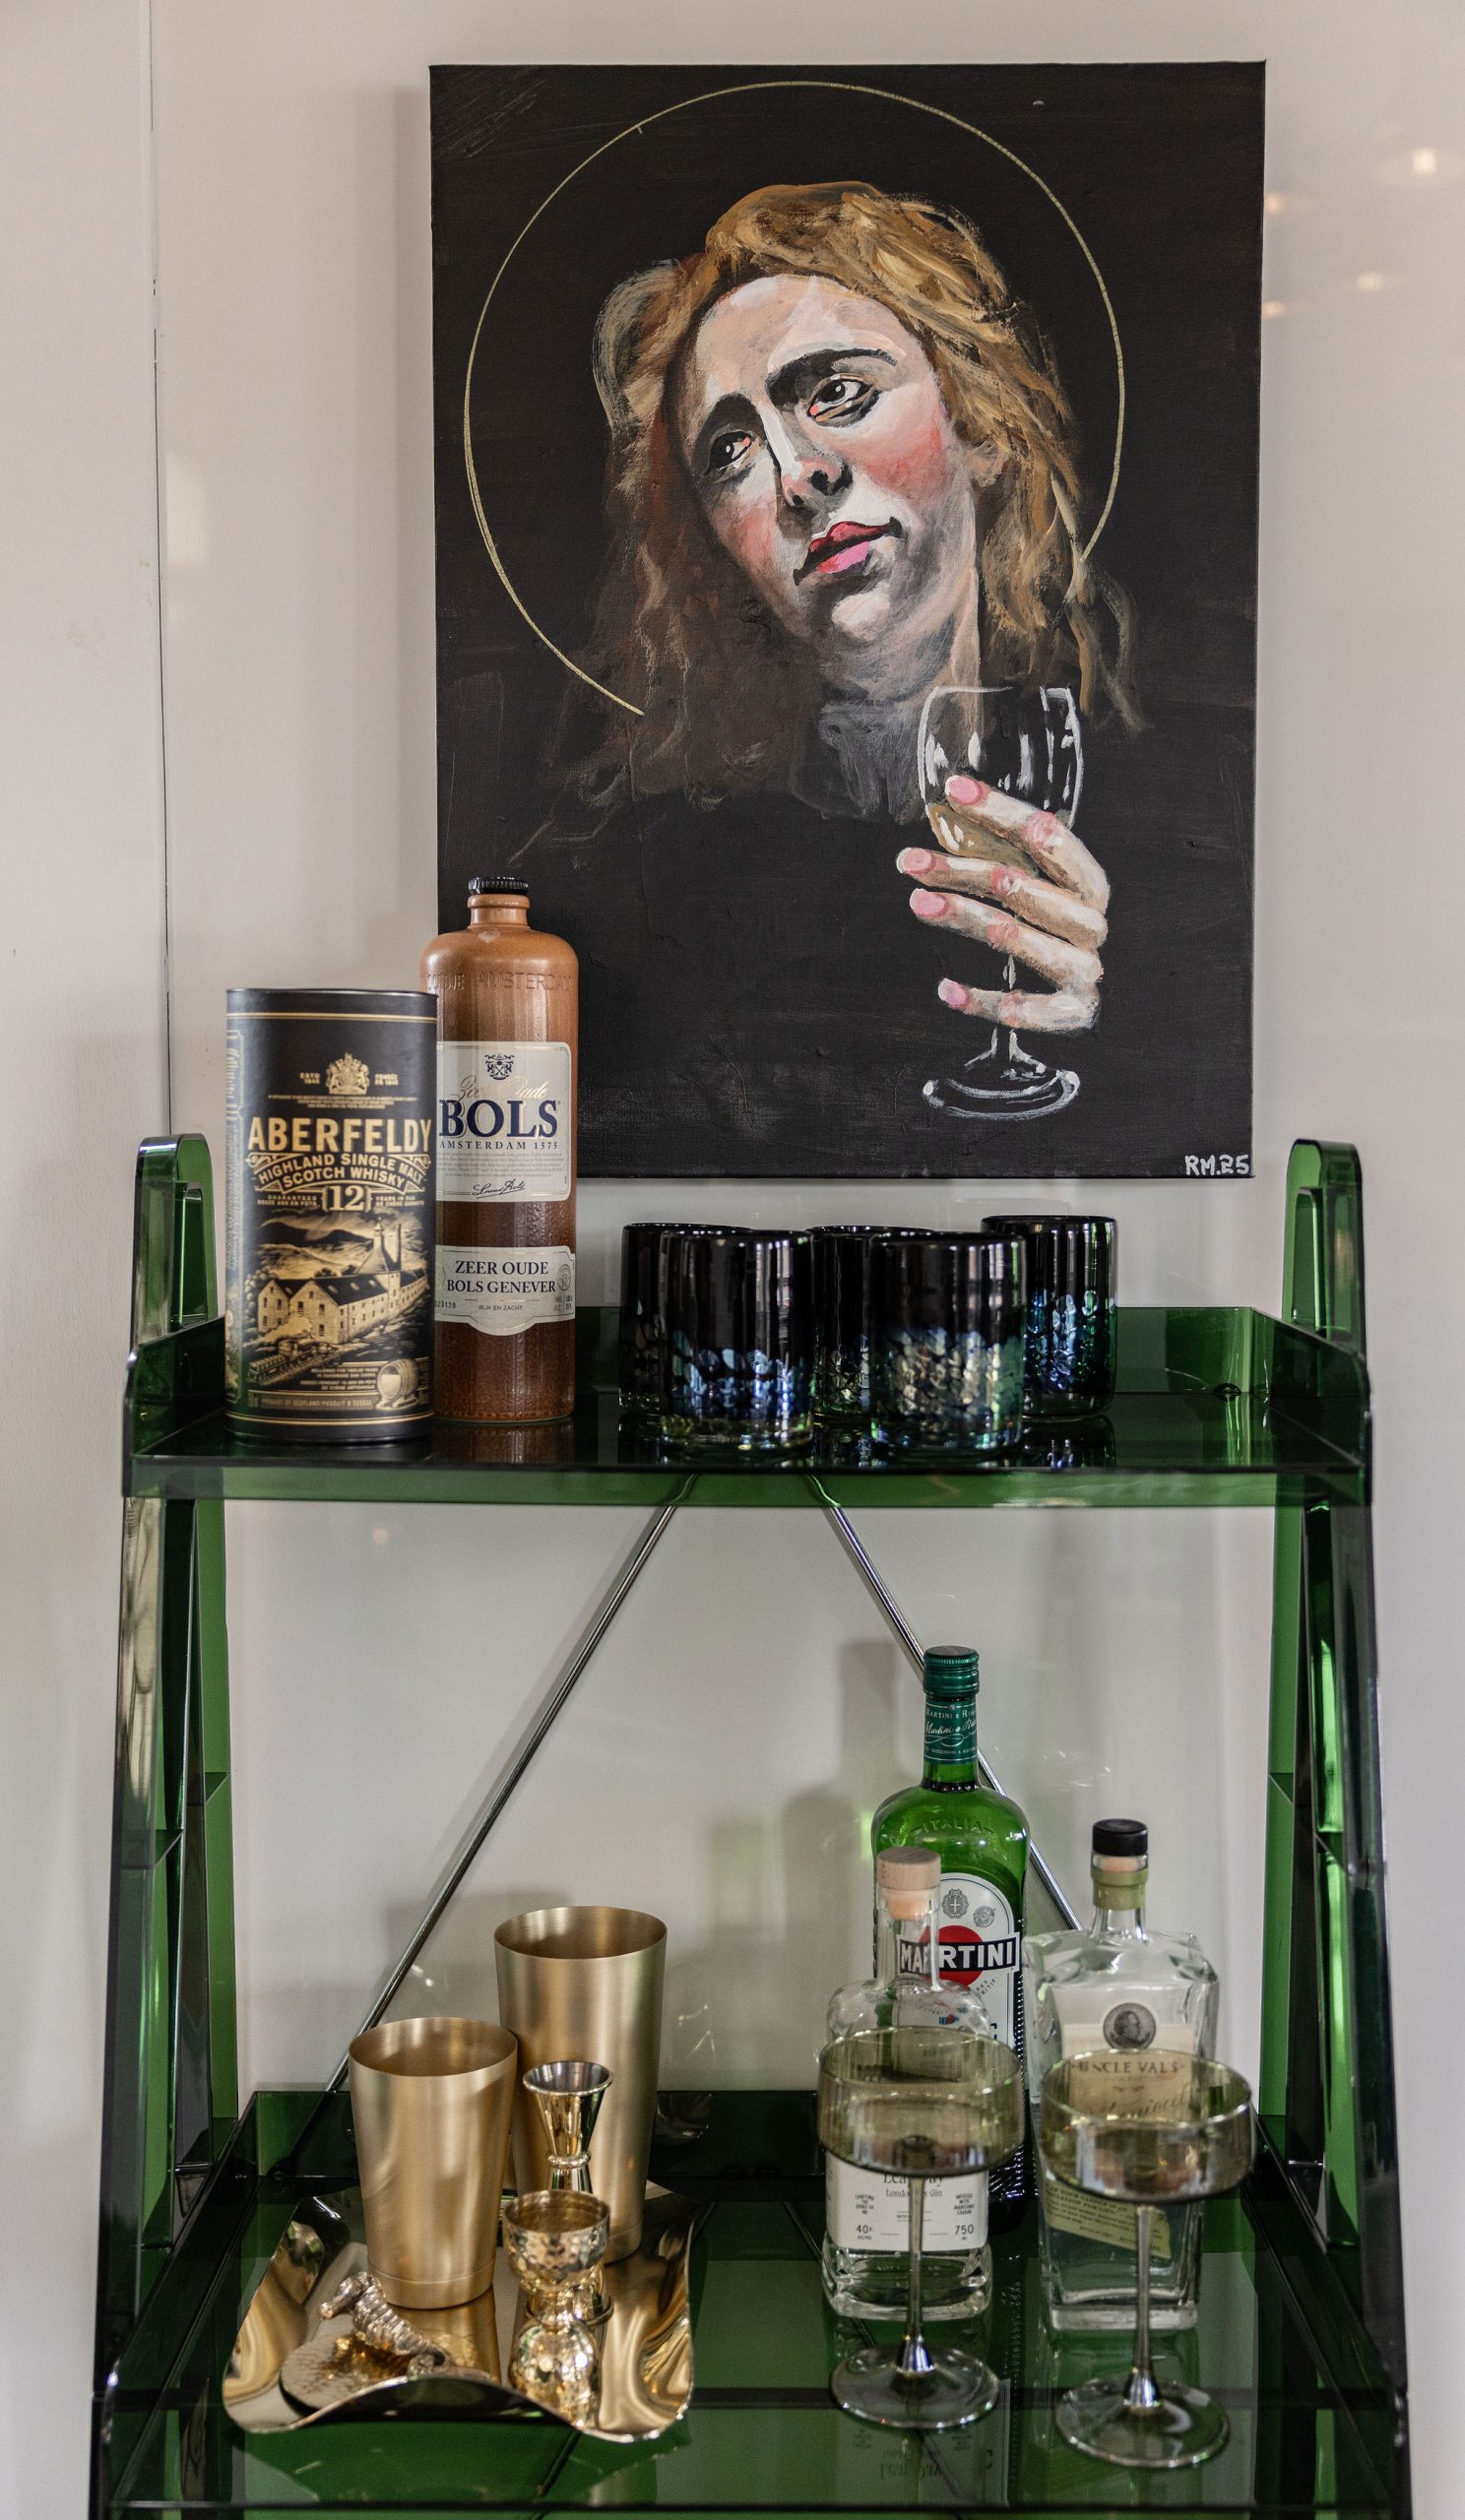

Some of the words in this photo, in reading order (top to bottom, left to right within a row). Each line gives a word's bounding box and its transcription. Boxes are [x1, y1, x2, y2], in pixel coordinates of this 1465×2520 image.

[439, 1099, 558, 1139] BOLS
[248, 1116, 432, 1154] ABERFELDY
[439, 1141, 526, 1151] AMSTERDAM
[534, 1141, 558, 1151] 1575
[258, 1155, 336, 1184] HIGHLAND
[341, 1154, 396, 1171] SINGLE
[398, 1163, 424, 1185] MALT
[284, 1166, 345, 1188] SCOTCH
[350, 1166, 405, 1188] WHISKY
[328, 1185, 364, 1212] 12
[455, 1260, 498, 1275] ZEER
[502, 1261, 549, 1276] OUDE
[447, 1279, 484, 1293] BOLS
[486, 1281, 557, 1294] GENEVER
[901, 1940, 1014, 1973] MARTINI
[1078, 2060, 1132, 2073] UNCLE
[886, 2188, 912, 2198] Londo
[929, 2188, 943, 2197] Gin
[955, 2224, 975, 2236] 750
